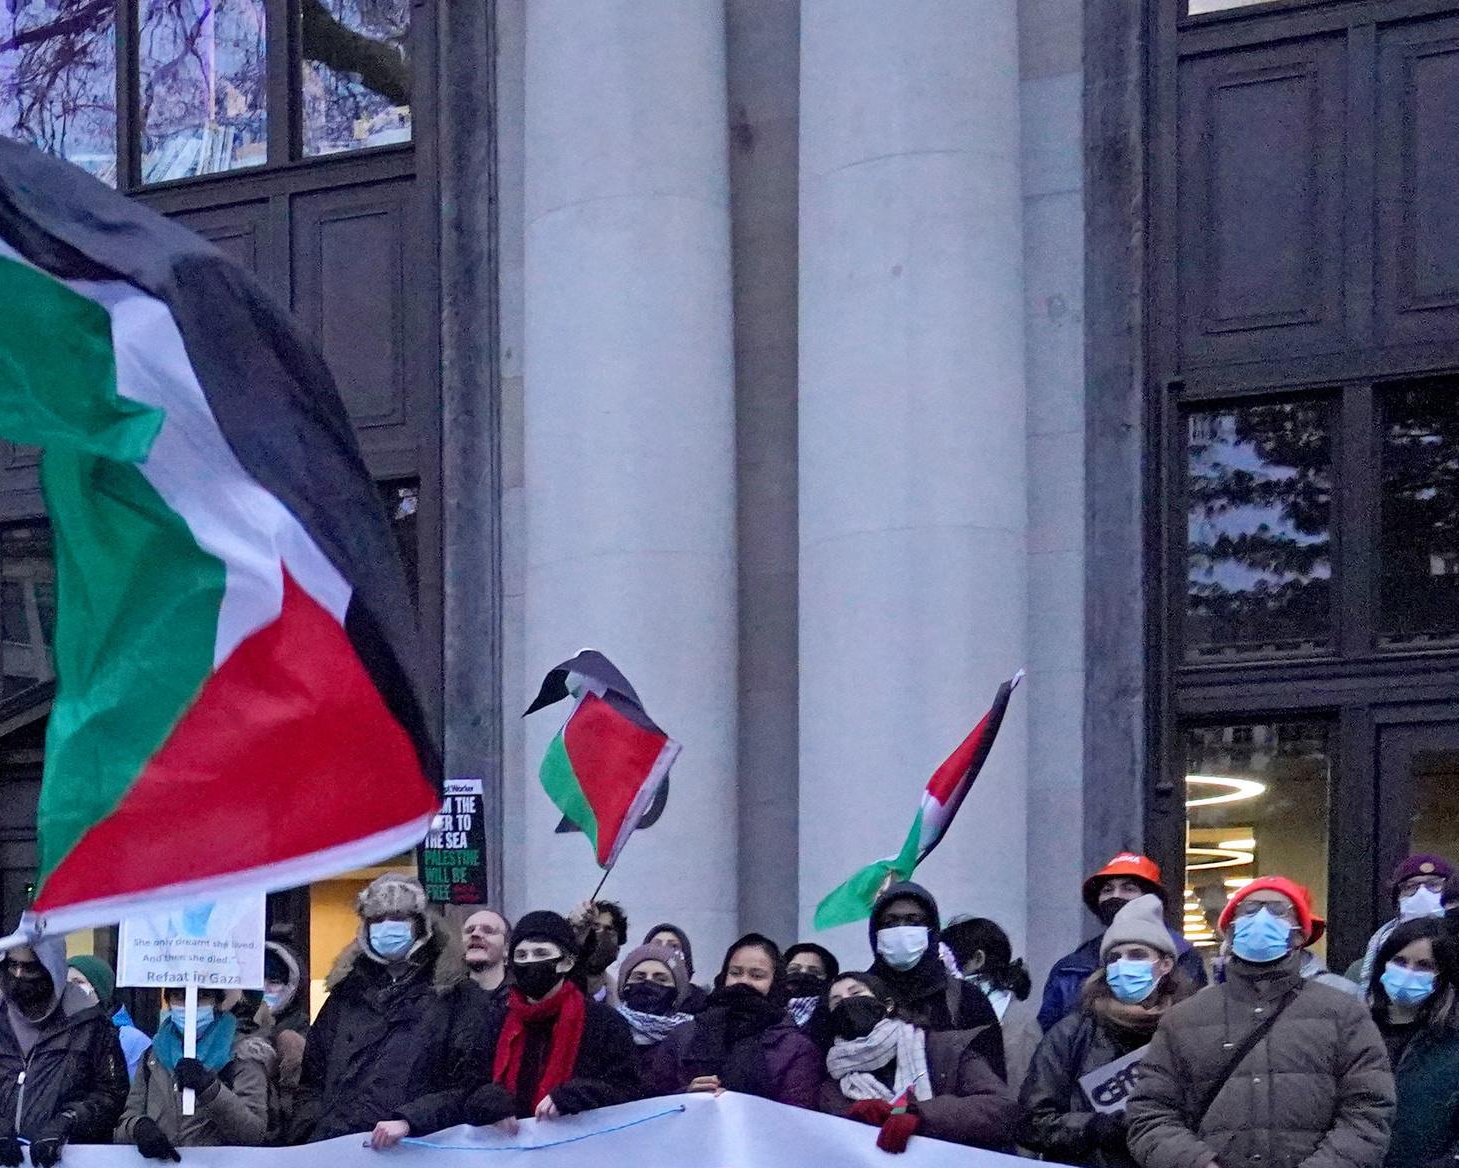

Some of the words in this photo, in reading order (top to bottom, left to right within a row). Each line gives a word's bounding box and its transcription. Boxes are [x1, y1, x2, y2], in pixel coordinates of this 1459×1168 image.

[454, 796, 476, 813] THE
[456, 814, 472, 831] TO
[445, 831, 468, 849] SEA
[146, 970, 189, 983] Refaat
[193, 971, 206, 983] in
[209, 972, 243, 985] Gaza
